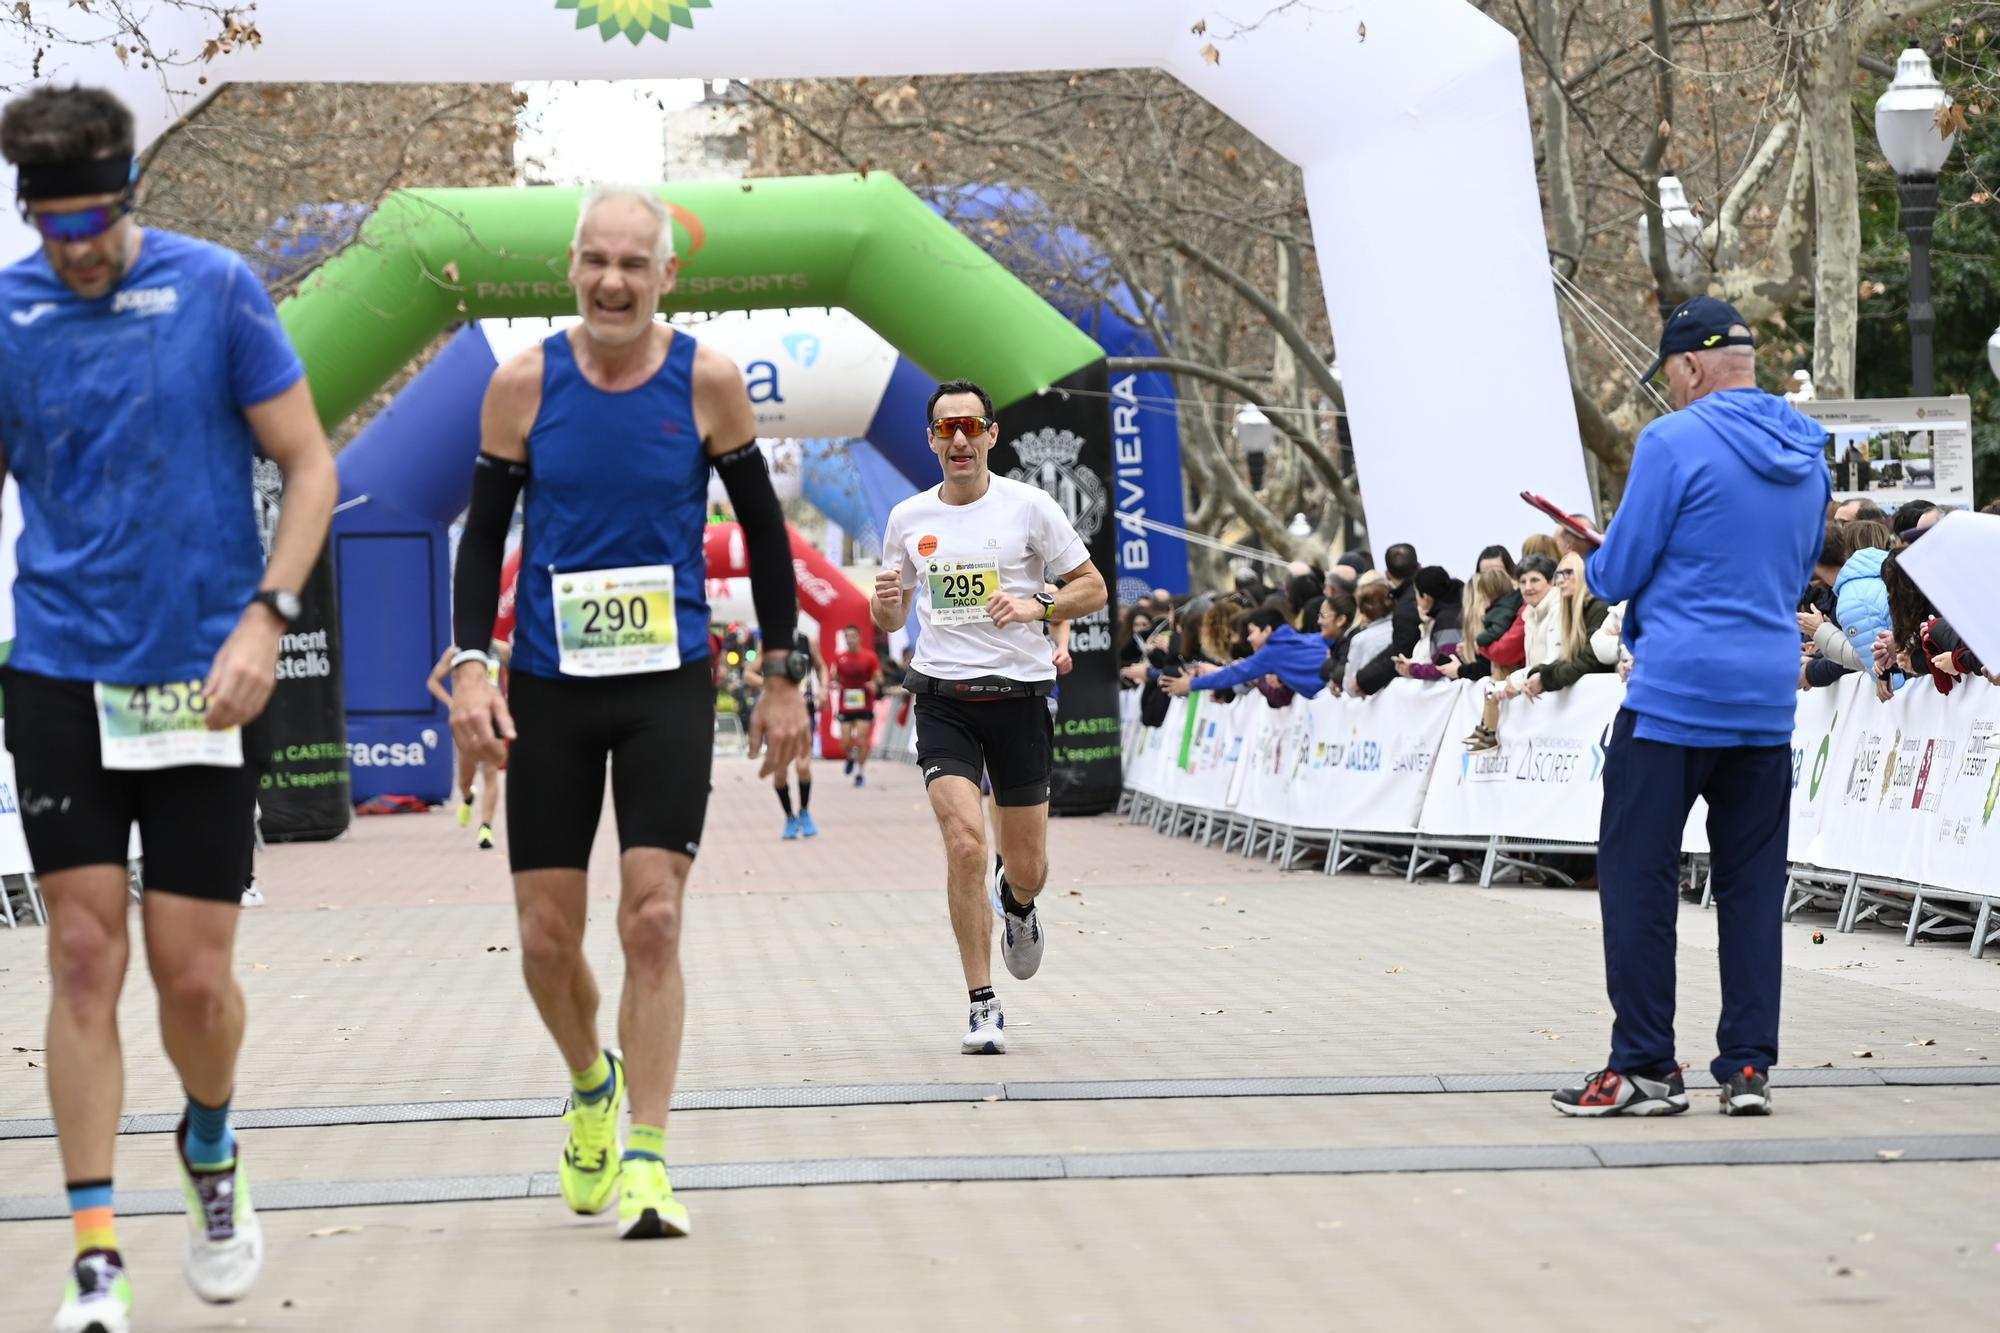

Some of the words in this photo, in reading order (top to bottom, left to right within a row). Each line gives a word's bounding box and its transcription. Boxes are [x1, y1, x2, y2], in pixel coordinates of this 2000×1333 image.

[477, 281, 577, 300] PATRO
[673, 272, 808, 296] ESPORTS
[1111, 373, 1150, 570] BAVIERA
[942, 573, 985, 599] 295
[581, 595, 649, 634] 290
[952, 597, 978, 608] PACO
[278, 628, 329, 652] ment
[1069, 625, 1112, 653] telló
[275, 651, 331, 681] stelló
[128, 681, 209, 717] 458
